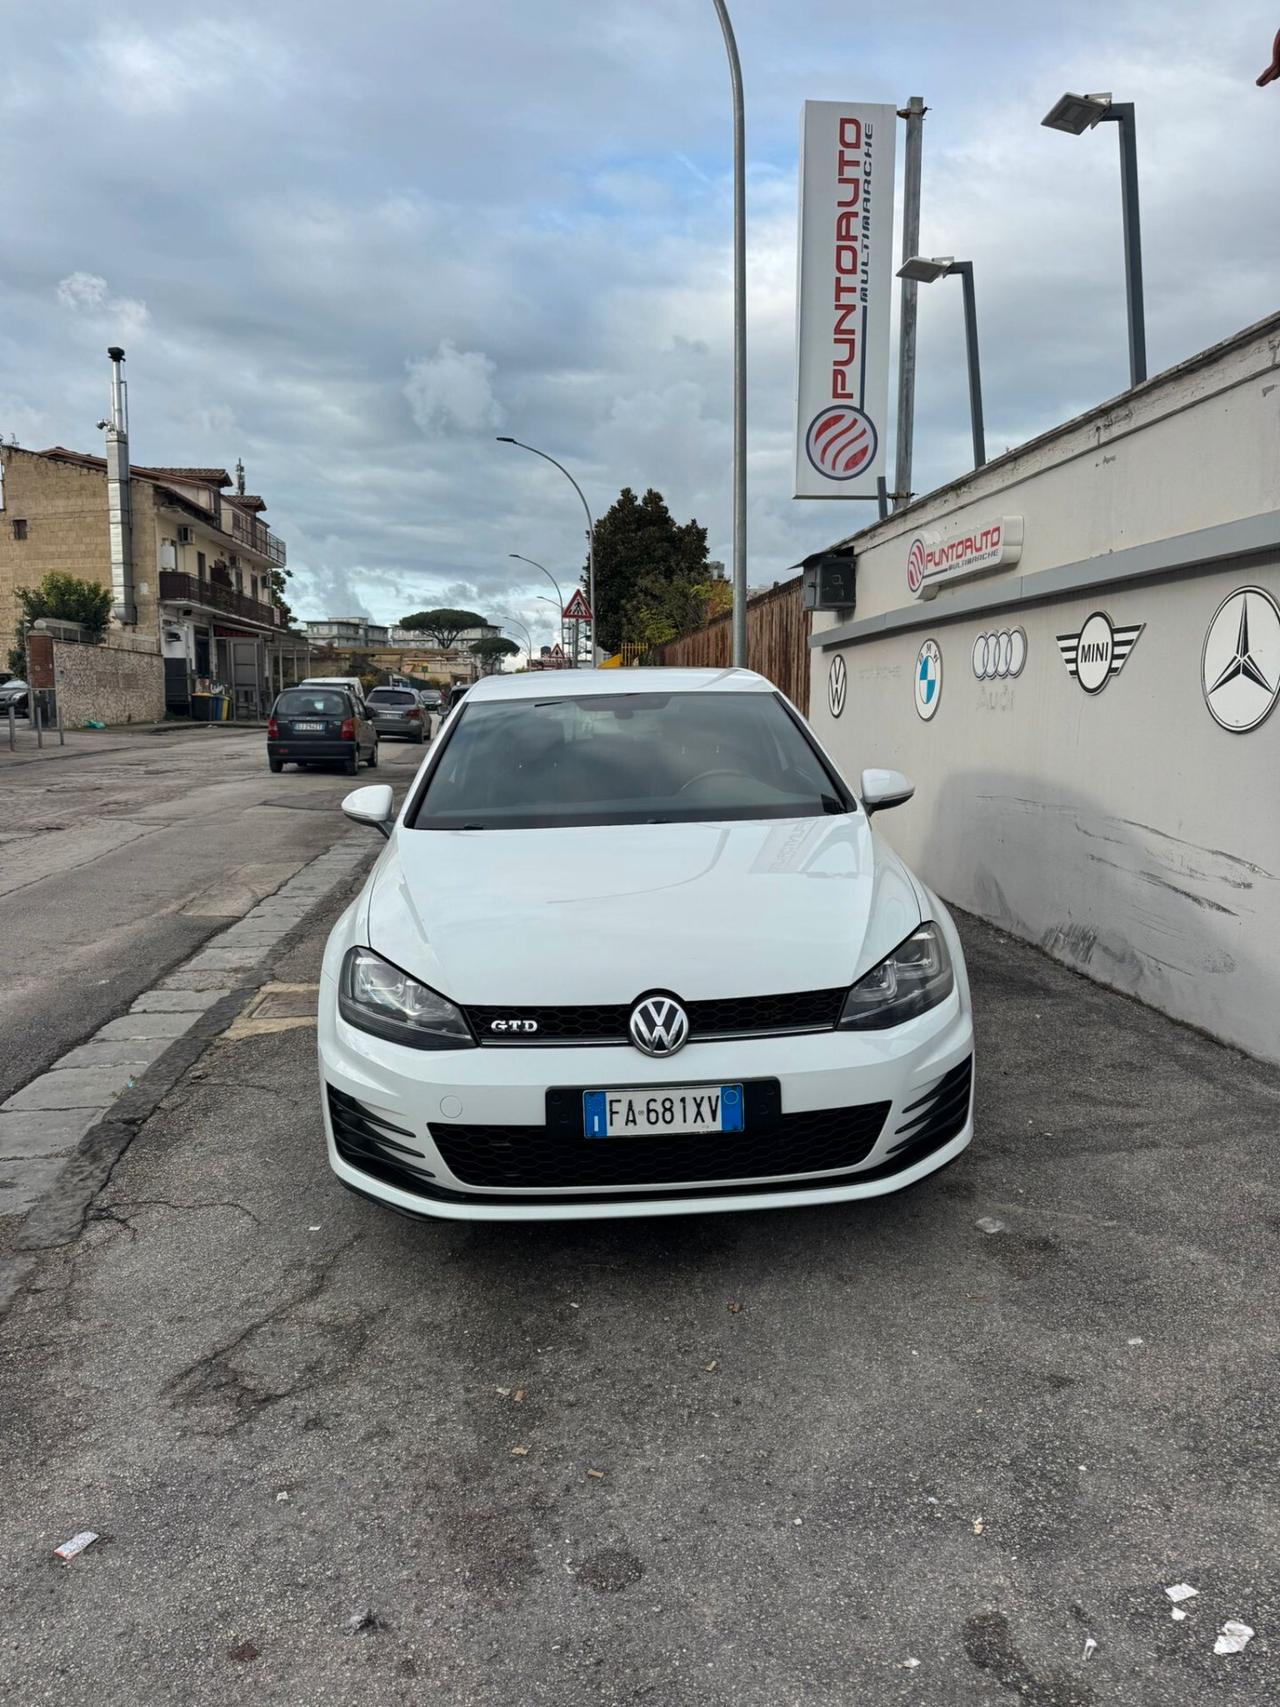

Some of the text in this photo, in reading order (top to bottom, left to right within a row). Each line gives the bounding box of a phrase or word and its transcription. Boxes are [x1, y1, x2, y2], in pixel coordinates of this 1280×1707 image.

[859, 122, 874, 303] MULTIMARCHE
[832, 117, 862, 400] PUNTOAUTO
[924, 526, 1001, 570] PUNTOAUTO
[1080, 641, 1109, 663] MINI
[490, 1020, 538, 1032] GTD
